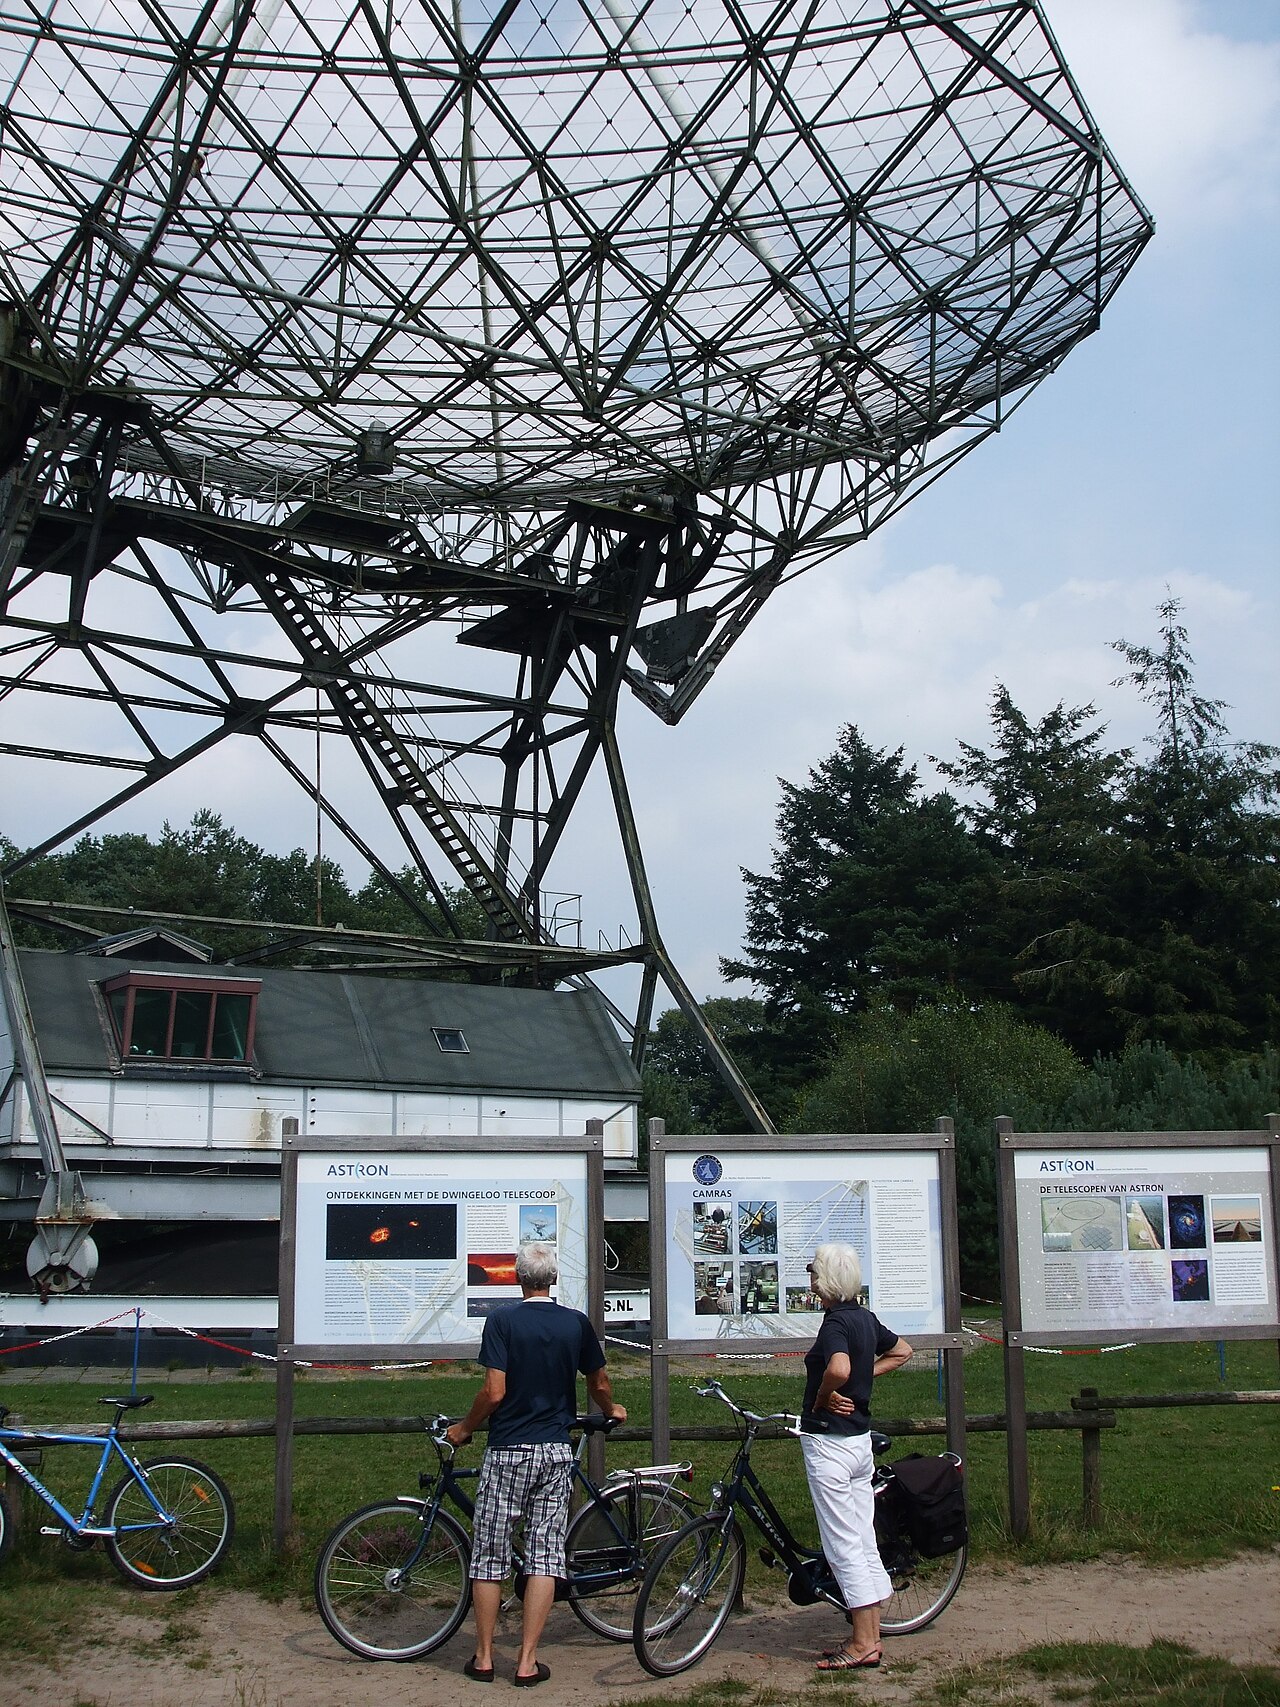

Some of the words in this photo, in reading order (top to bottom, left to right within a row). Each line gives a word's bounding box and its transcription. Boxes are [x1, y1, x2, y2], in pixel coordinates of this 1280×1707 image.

[327, 1163, 389, 1177] ASTRON
[1039, 1159, 1095, 1173] ASTRON
[692, 1189, 732, 1198] CAMRAS
[1040, 1185, 1052, 1194] DE
[1053, 1184, 1107, 1194] TELESCOPEN
[1108, 1184, 1127, 1193] VAN
[1129, 1183, 1164, 1192] ASTRON
[326, 1190, 402, 1200] ONTDEKKINGEN
[404, 1190, 425, 1200] MET
[426, 1190, 440, 1200] DE
[441, 1190, 501, 1200] DWINGELOO
[502, 1189, 556, 1199] TELESCOOP
